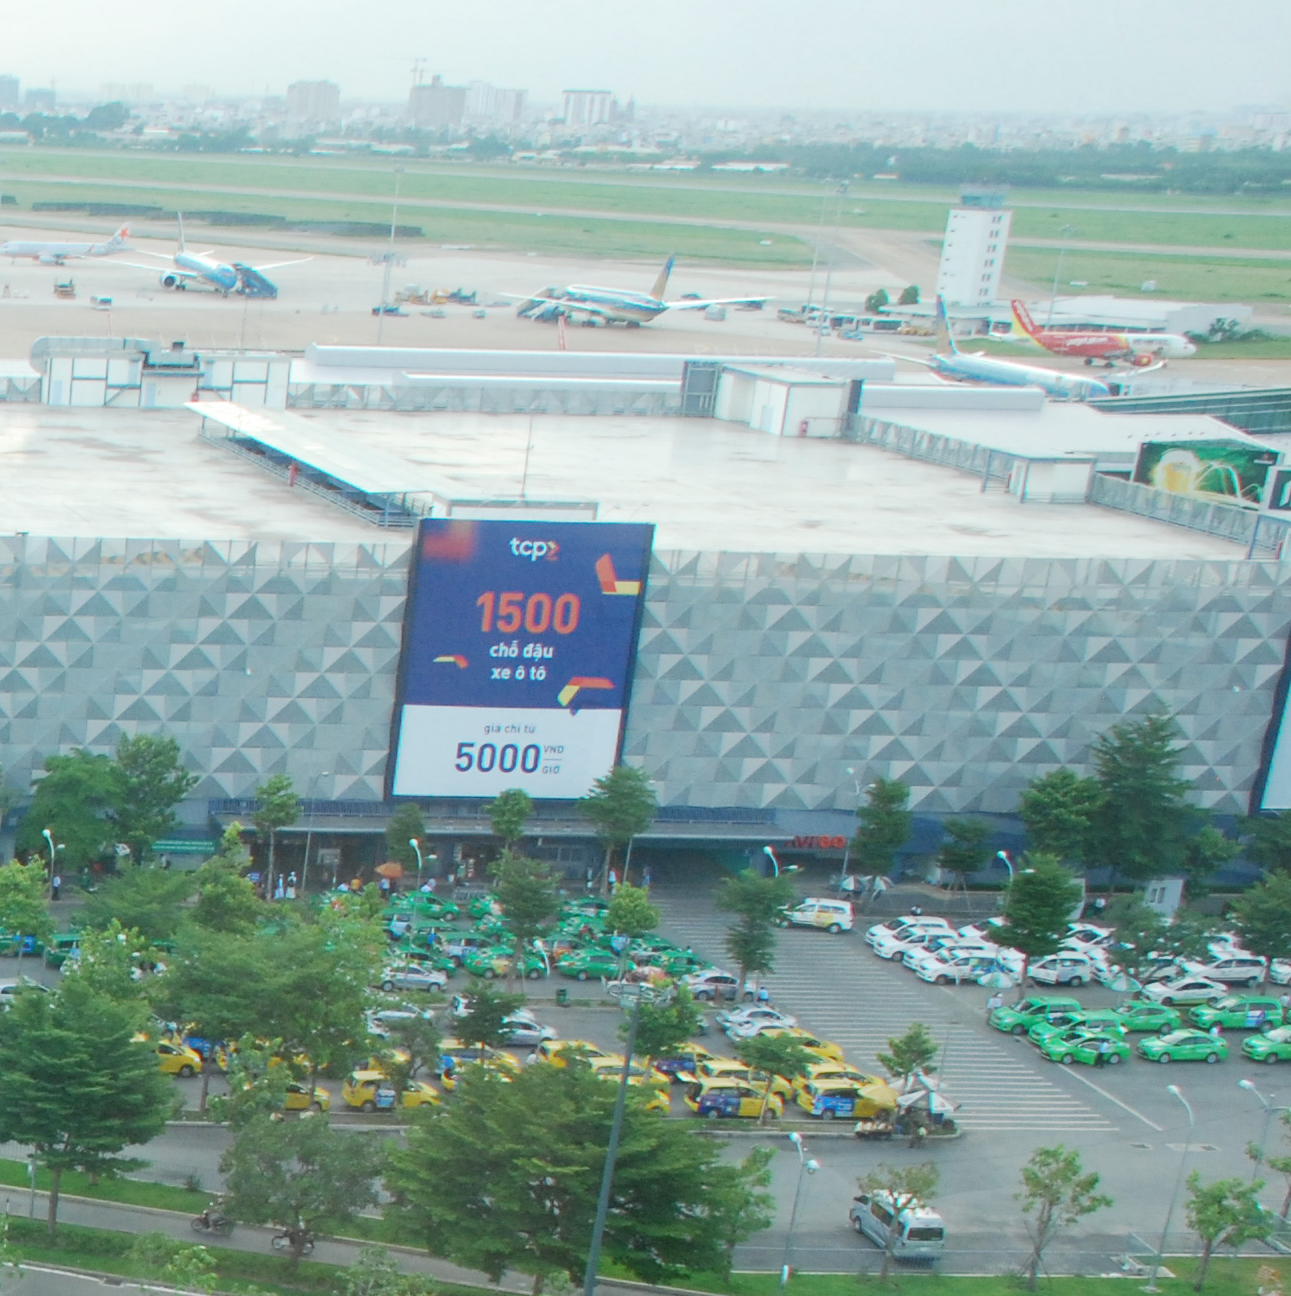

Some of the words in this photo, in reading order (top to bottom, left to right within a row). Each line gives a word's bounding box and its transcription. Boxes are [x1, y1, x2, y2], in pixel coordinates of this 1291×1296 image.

[476, 591, 581, 634] 1500
[489, 640, 519, 658] chỗ
[523, 643, 554, 662] đậu
[491, 667, 511, 680] xe
[515, 665, 525, 681] ô
[530, 666, 547, 681] tô
[455, 742, 540, 774] 5000
[543, 745, 564, 754] VND
